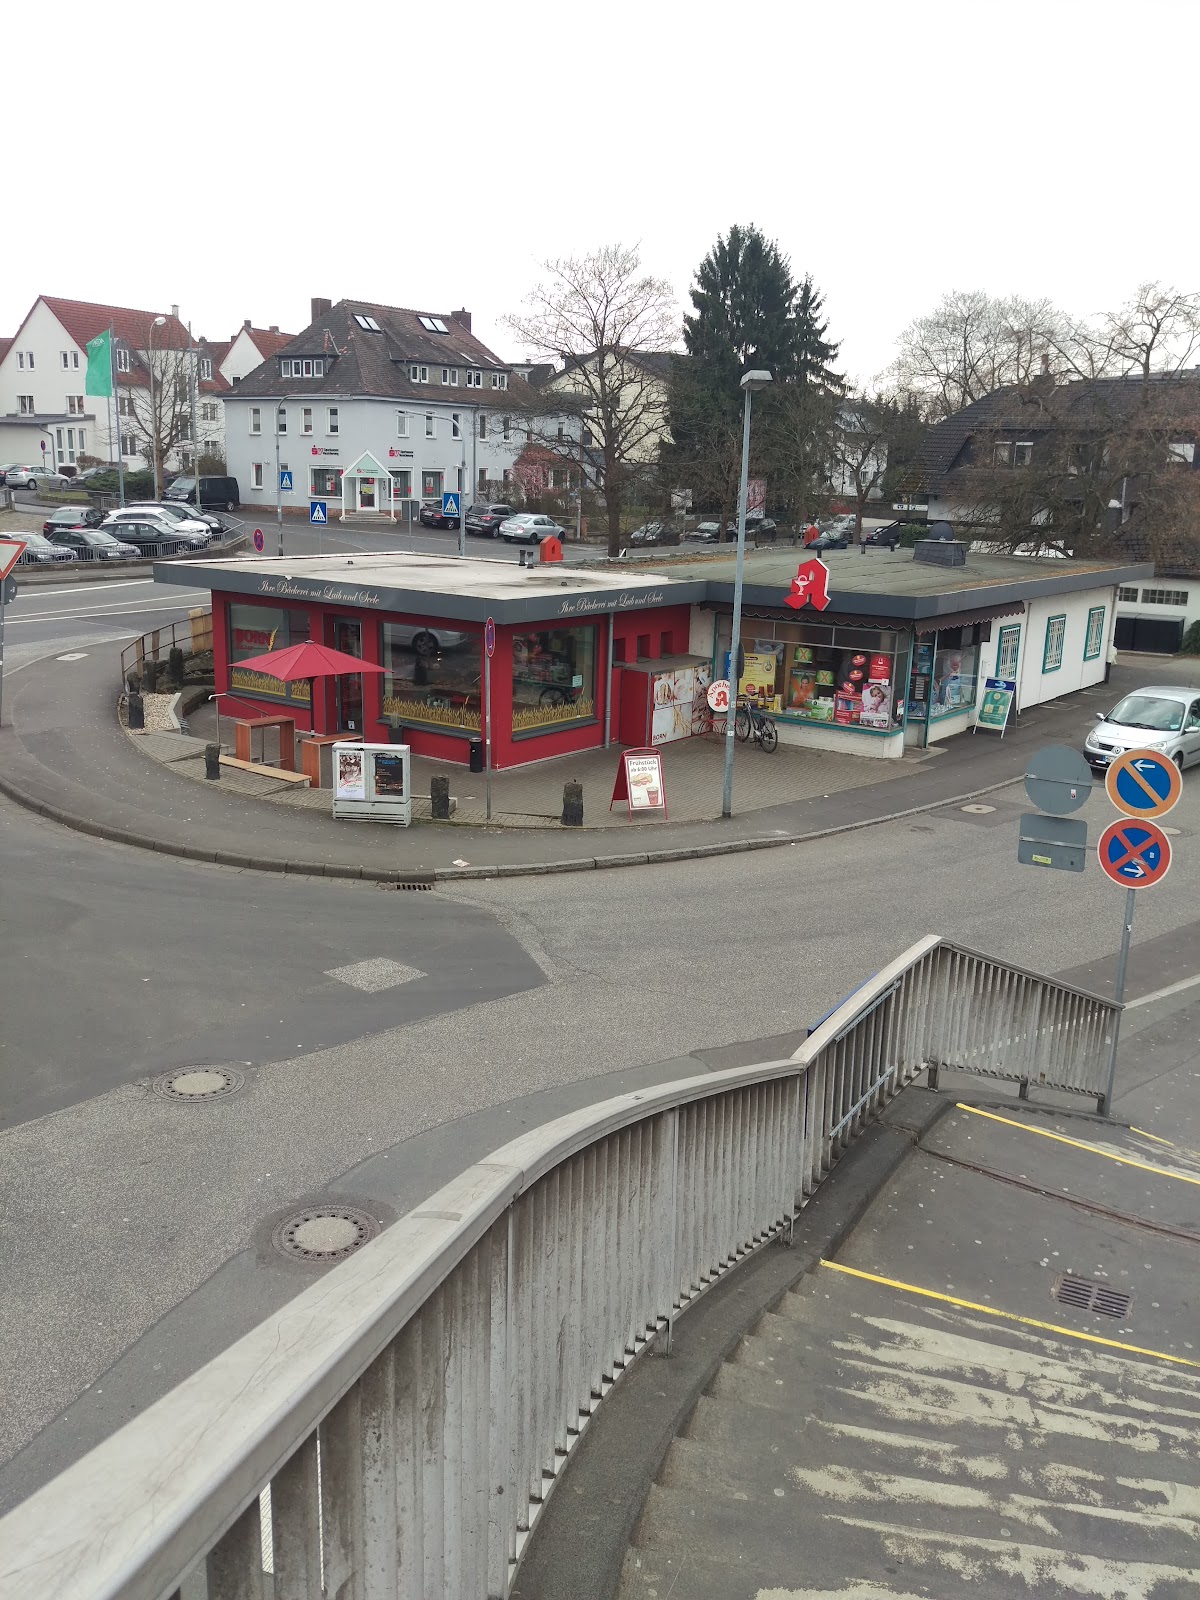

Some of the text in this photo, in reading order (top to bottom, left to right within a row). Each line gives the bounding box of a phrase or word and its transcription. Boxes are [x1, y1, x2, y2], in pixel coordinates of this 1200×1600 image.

[258, 580, 380, 605] Ihre Bäckerei mit Laib und Seele
[557, 590, 664, 615] Ihre Bäckerei mit Laib und Seele
